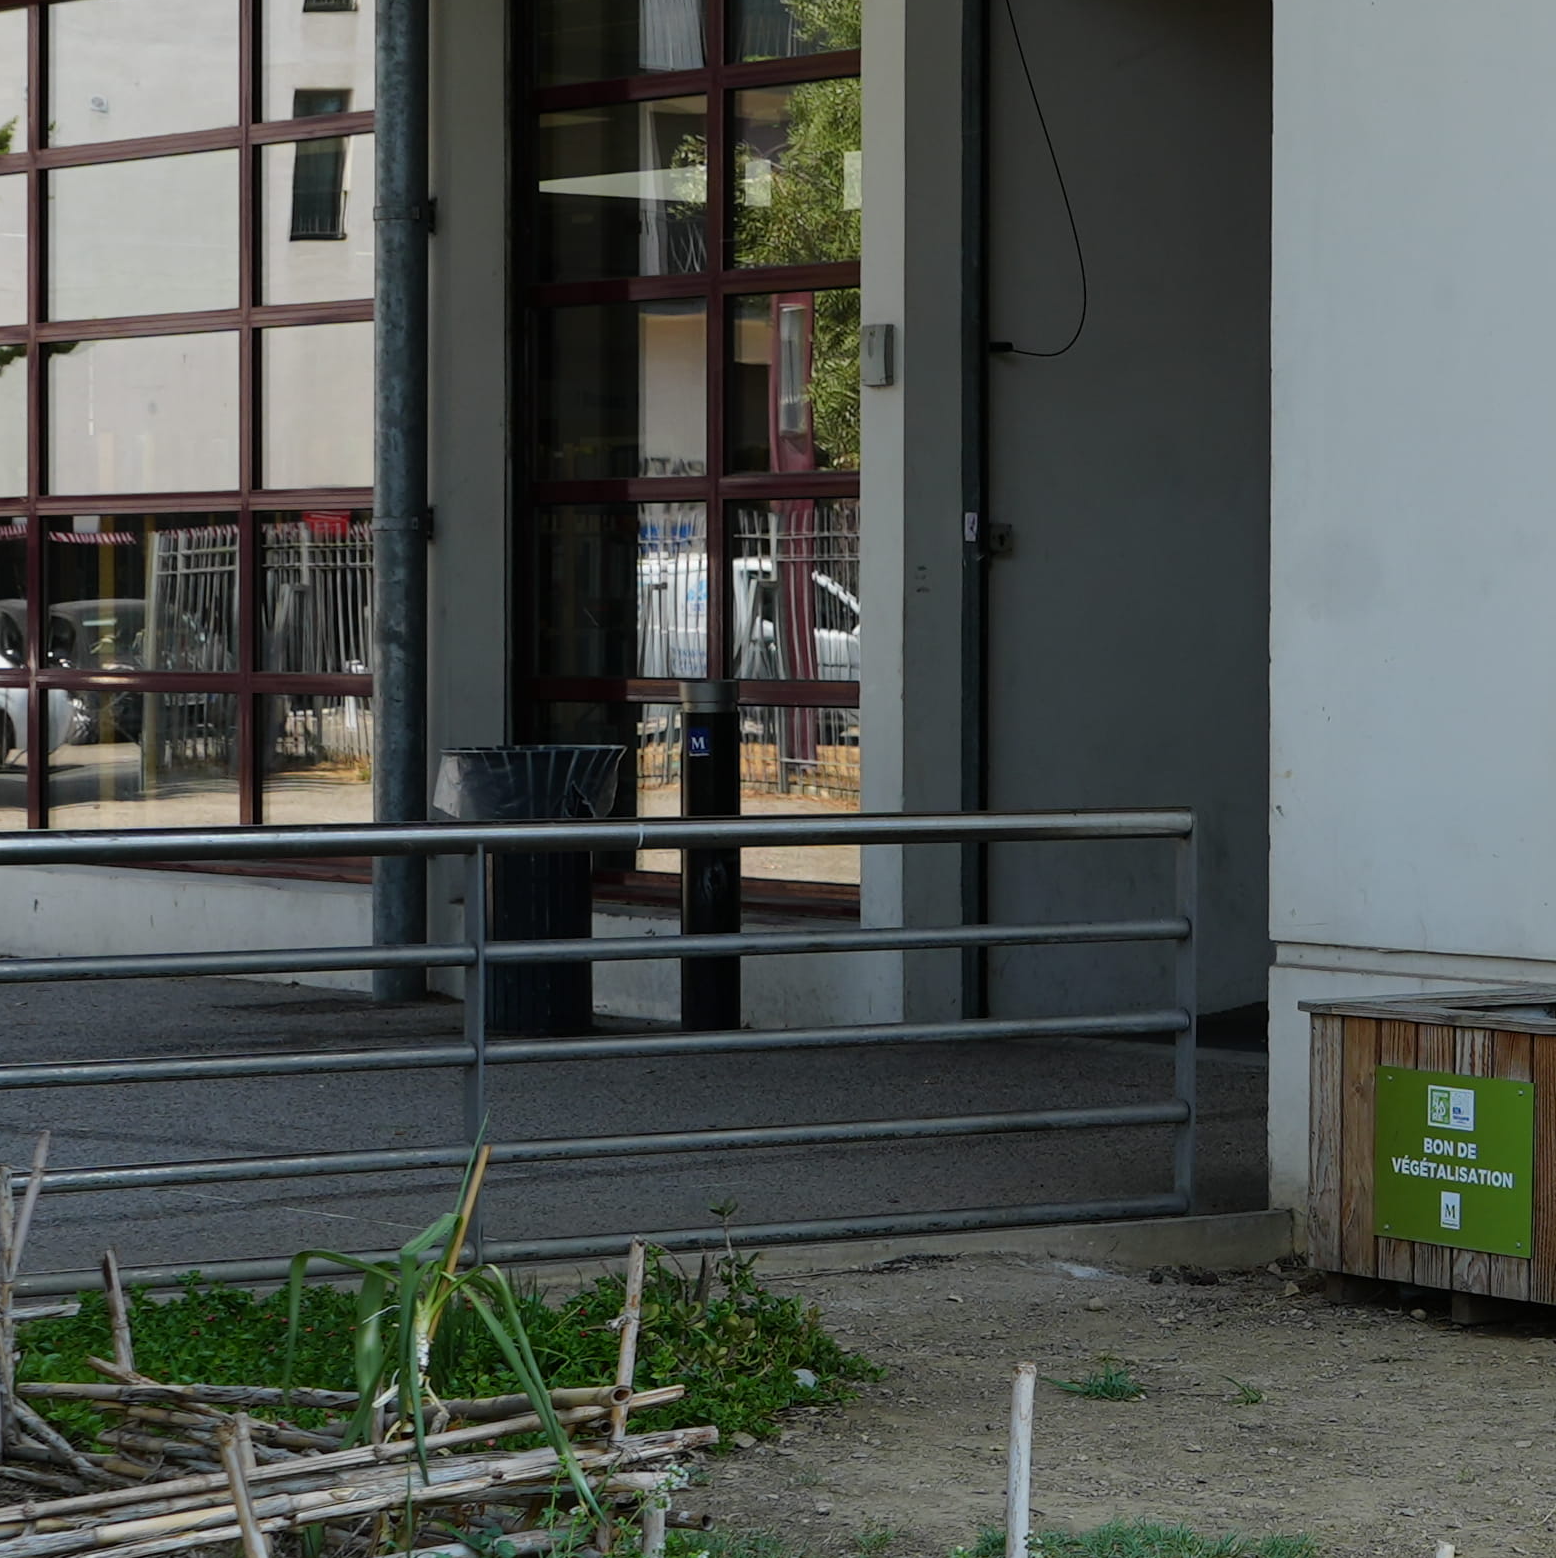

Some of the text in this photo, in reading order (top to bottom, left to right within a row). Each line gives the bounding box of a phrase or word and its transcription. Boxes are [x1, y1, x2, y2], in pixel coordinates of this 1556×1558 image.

[1423, 1137, 1477, 1160] BON DE
[1392, 1155, 1513, 1189] VÉGÉTALISATION
